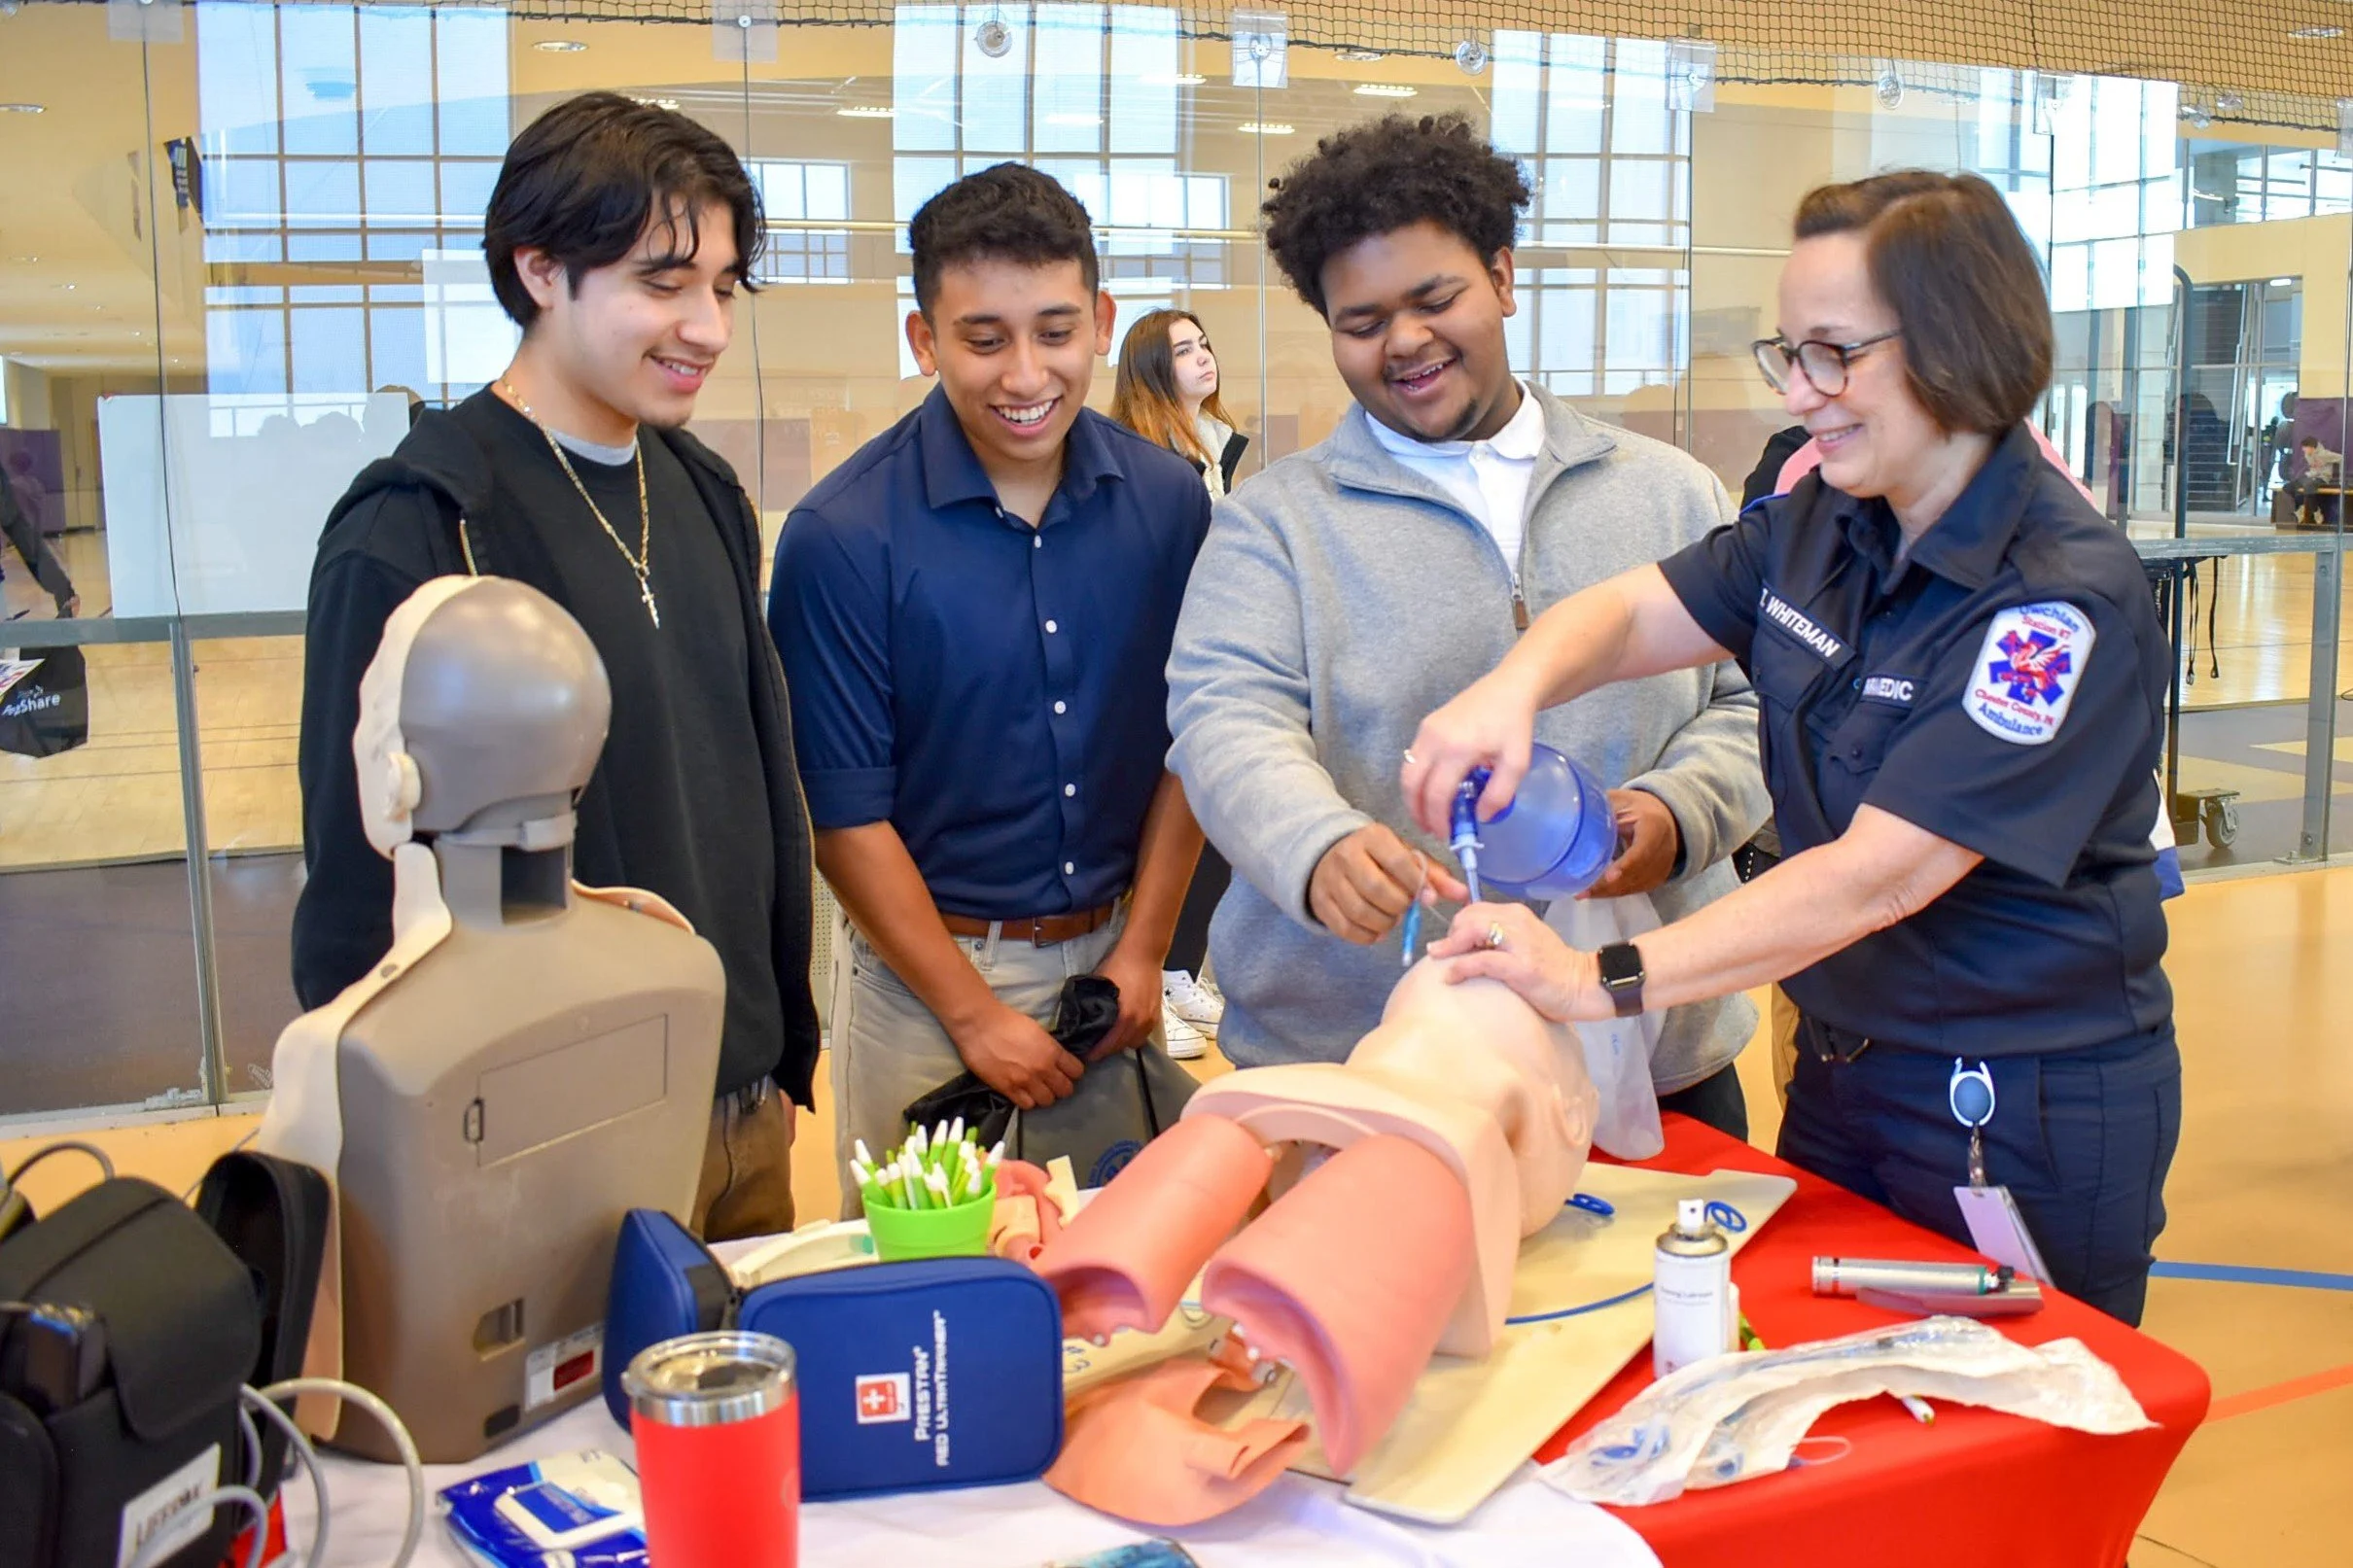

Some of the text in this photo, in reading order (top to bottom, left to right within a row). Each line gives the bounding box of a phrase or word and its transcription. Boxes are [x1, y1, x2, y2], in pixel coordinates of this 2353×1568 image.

[1766, 596, 1841, 658] WHITEMAN
[2021, 615, 2056, 635] Station
[1979, 703, 2044, 736] Ambulance
